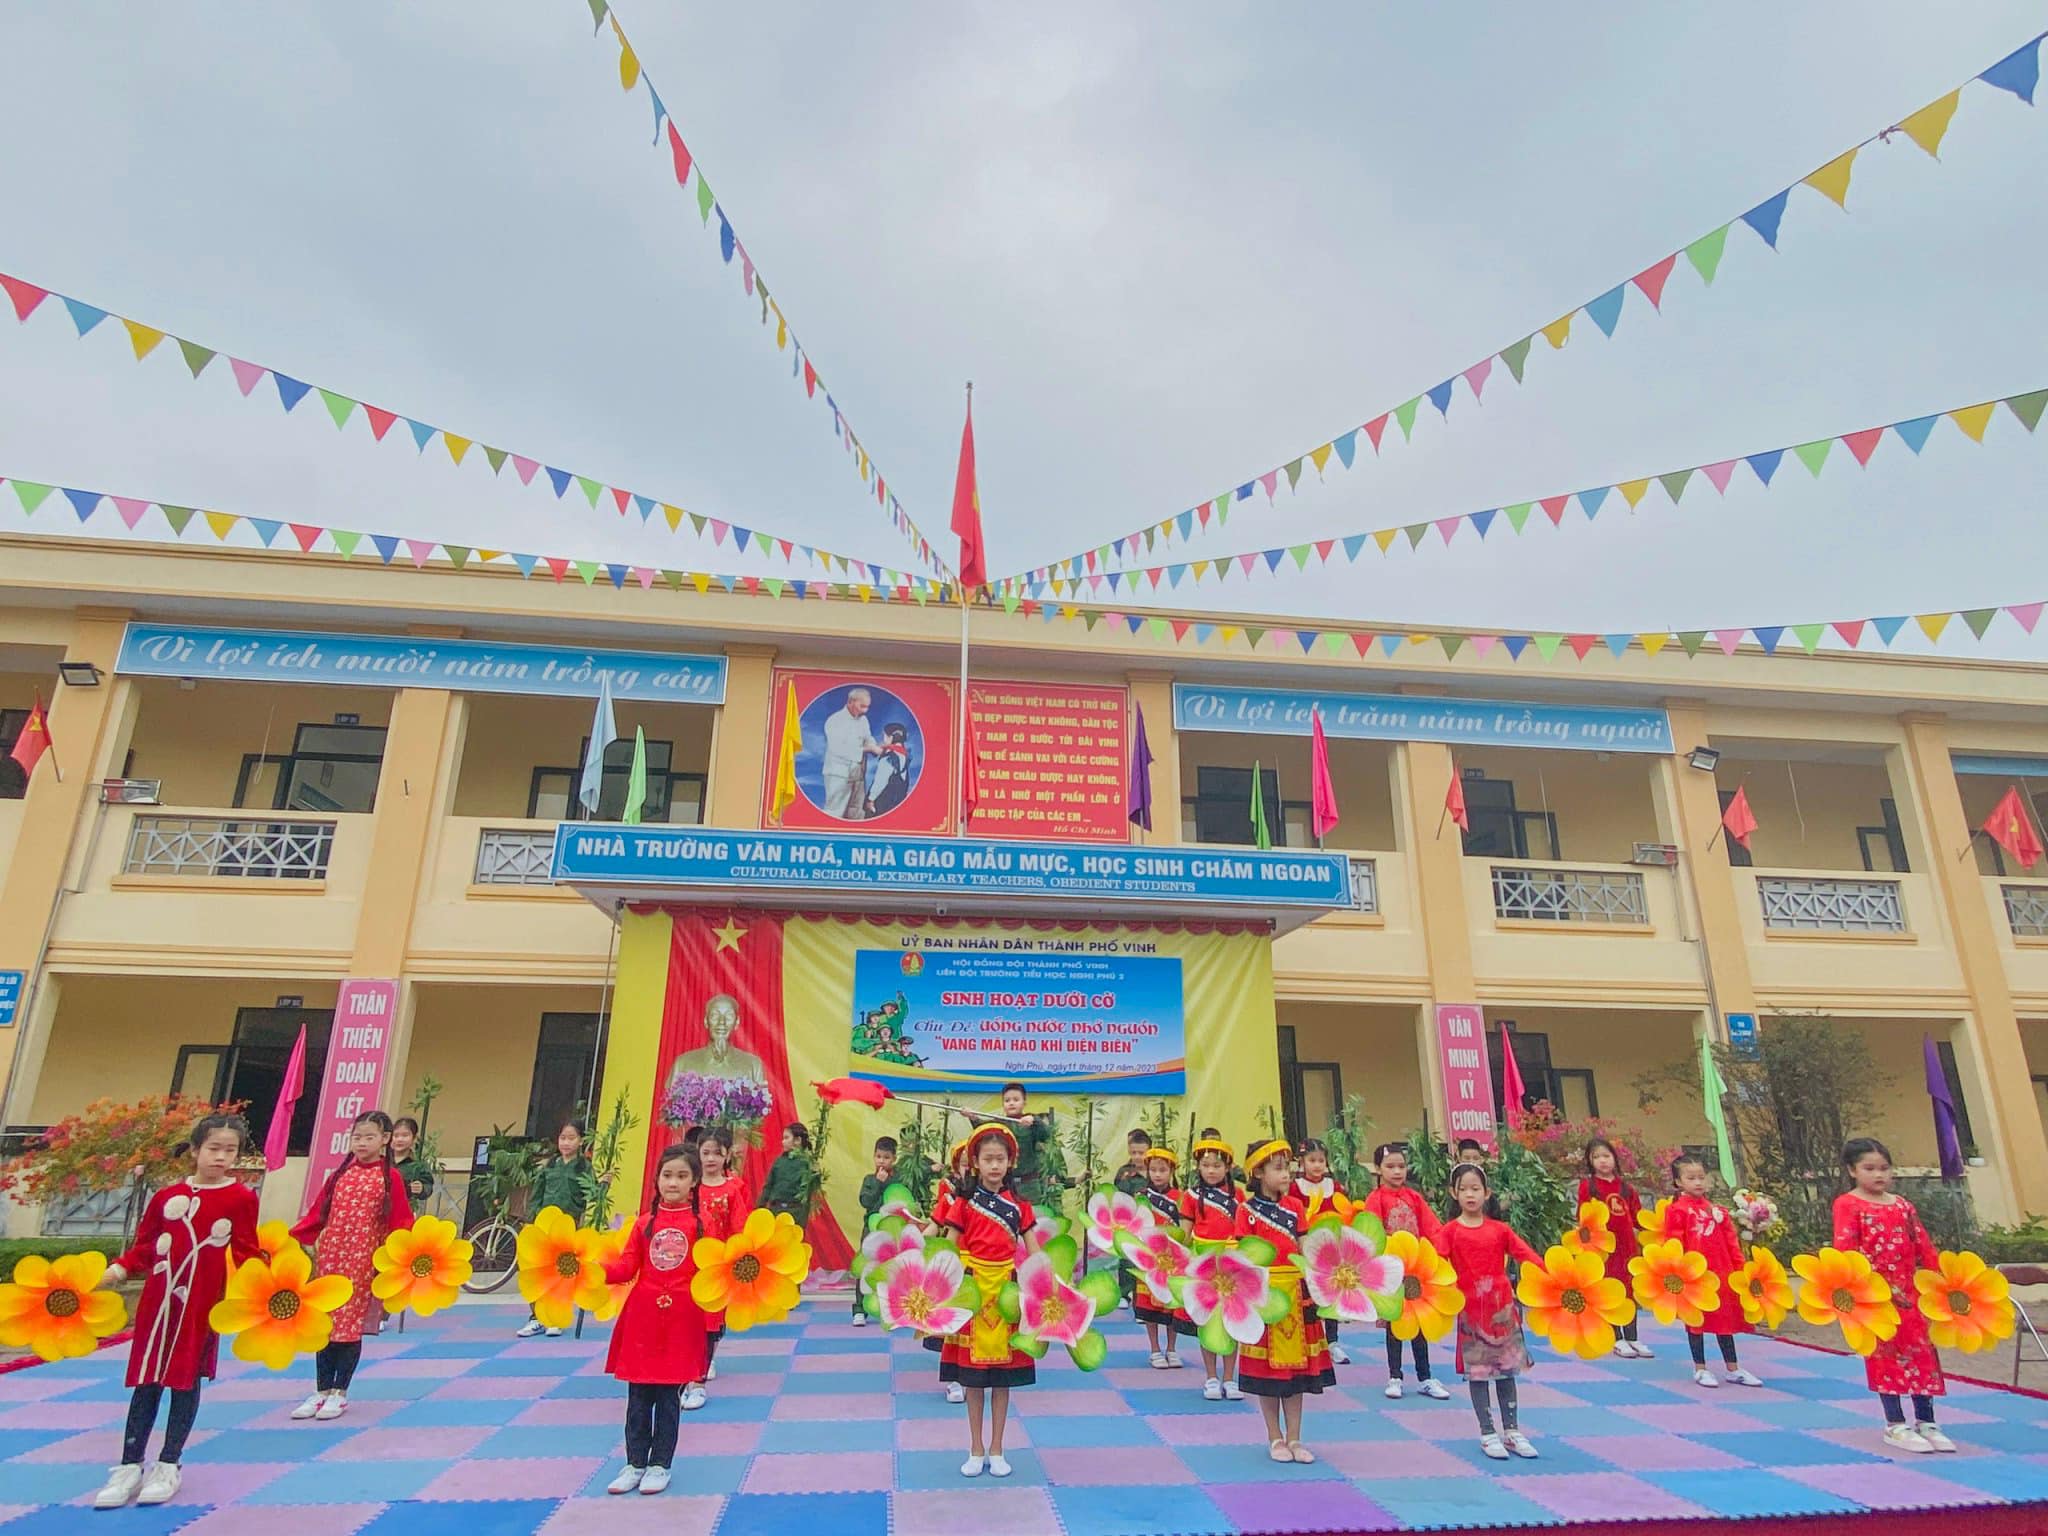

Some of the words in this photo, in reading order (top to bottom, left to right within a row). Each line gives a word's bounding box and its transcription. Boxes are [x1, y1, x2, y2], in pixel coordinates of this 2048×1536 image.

[140, 636, 197, 662] Vì
[206, 639, 259, 671] lợi
[267, 643, 323, 669] ích
[335, 647, 437, 674] mười
[444, 655, 529, 680] năm
[541, 656, 640, 690] trồng
[652, 667, 714, 694] cây
[1000, 694, 1024, 705] SÔNG
[1025, 696, 1042, 708] VIỆT
[1046, 698, 1066, 708] NAM
[1029, 716, 1047, 725] HAY
[1048, 716, 1080, 728] KHÔNG,
[1102, 719, 1119, 730] TỘC
[1184, 695, 1225, 719] Vì
[1236, 698, 1275, 726] lợi
[1337, 705, 1409, 728] trăm
[1418, 709, 1484, 731] năm
[1494, 709, 1570, 740] trồng
[1581, 718, 1663, 744] người
[986, 732, 1008, 742] NAM
[1036, 752, 1050, 762] VAI
[1053, 752, 1067, 764] VỚI
[1069, 754, 1087, 765] CÁC
[1090, 755, 1119, 766] CƯỜNG
[1013, 770, 1037, 781] CHÂU
[1067, 773, 1084, 784] HAY
[1087, 773, 1120, 786] KHÔNG,
[994, 788, 1006, 799] LÀ
[1036, 790, 1055, 803] MỘT
[987, 808, 1006, 820] HỌC
[1007, 808, 1025, 821] TẬP
[1027, 807, 1045, 820] CỦA
[1047, 810, 1065, 821] CÁC
[1067, 812, 1081, 822] EM
[1070, 825, 1089, 834] Chí
[1090, 826, 1117, 835] Minh
[577, 834, 626, 857] NHÀ
[634, 837, 729, 861] TRƯỜNG
[736, 840, 782, 863] VĂN
[790, 843, 843, 867] HOÁ,
[850, 844, 897, 866] NHÀ
[904, 847, 956, 869] GIÁO
[963, 846, 1012, 871] MẪU
[1019, 853, 1076, 876] MỰC,
[1083, 856, 1127, 878] HỌC
[1134, 858, 1184, 877] SINH
[1190, 858, 1253, 880] CHĂM
[1261, 863, 1331, 883] NGOAN
[730, 866, 808, 880] CULTURAL
[812, 869, 872, 883] SCHOOL,
[877, 871, 966, 885] EXEMPLARY
[970, 874, 1047, 888] TEACHERS,
[1050, 877, 1121, 890] OBEDIENT
[1124, 880, 1196, 892] STUDENTS
[924, 937, 953, 948] BAN
[958, 937, 999, 949] NHÂN
[1003, 938, 1033, 950] DÂN
[1038, 939, 1084, 951] THÀNH
[1089, 939, 1118, 952] PHỐ
[1123, 943, 1156, 953] VINH
[952, 958, 970, 967] HỘI
[1027, 960, 1059, 969] THÀNH
[1062, 960, 1082, 969] PHỐ
[959, 968, 977, 977] ĐỘI
[1044, 970, 1066, 979] HỌC
[349, 990, 387, 1015] THÂN
[942, 992, 985, 1005] SINH
[990, 993, 1038, 1009] HOẠT
[1043, 991, 1086, 1008] DƯỚI
[1091, 991, 1114, 1008] CỜ
[1448, 1015, 1472, 1038] VĂN
[342, 1023, 383, 1054] THIỆN
[981, 1036, 1006, 1051] MÃI
[1011, 1037, 1036, 1052] HÀO
[1041, 1038, 1062, 1052] KHÍ
[1067, 1038, 1096, 1054] ĐIỆN
[1005, 1061, 1024, 1072] Nghi
[1080, 1062, 1101, 1073] tháng
[1105, 1063, 1114, 1072] 12
[1136, 1063, 1156, 1072] 2023
[1448, 1048, 1479, 1068] MINH
[335, 1057, 377, 1083] ĐOÀN
[1459, 1071, 1474, 1099] KỶ
[335, 1089, 364, 1118] KẾT
[1452, 1109, 1491, 1131] CƯƠNG
